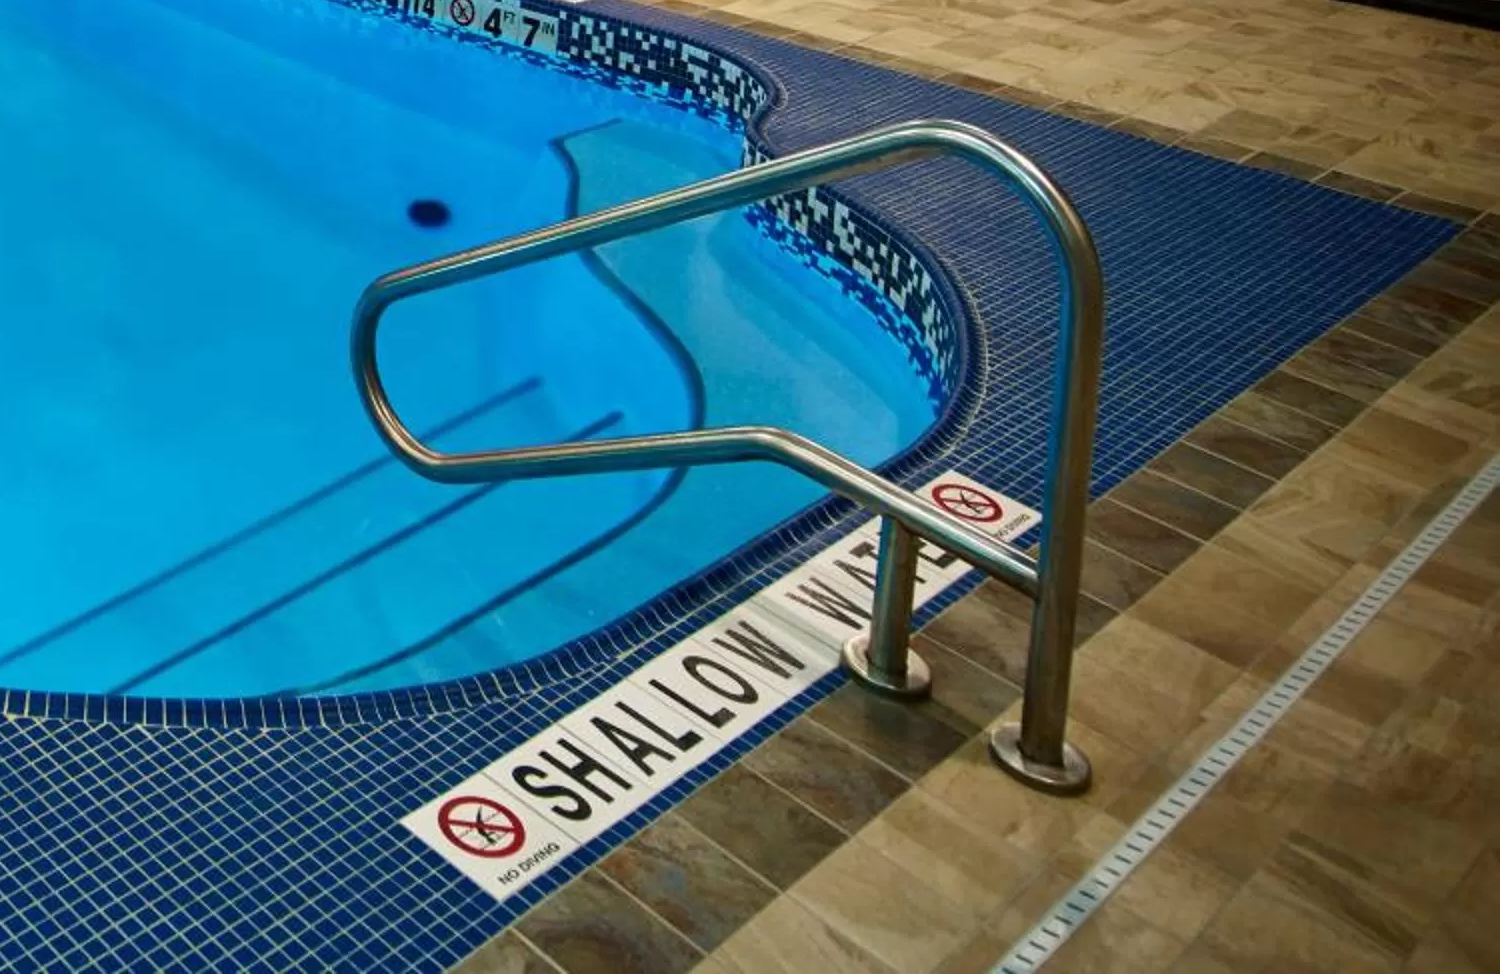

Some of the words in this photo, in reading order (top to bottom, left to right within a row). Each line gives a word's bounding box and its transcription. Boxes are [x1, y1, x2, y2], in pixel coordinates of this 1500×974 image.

[483, 8, 503, 38] 4
[504, 10, 516, 24] FT
[522, 15, 541, 47] 7
[541, 21, 555, 36] IN
[510, 618, 806, 822] SHALLOW
[786, 537, 960, 630] WATE
[498, 869, 521, 887] NO
[517, 842, 561, 873] DIVING
